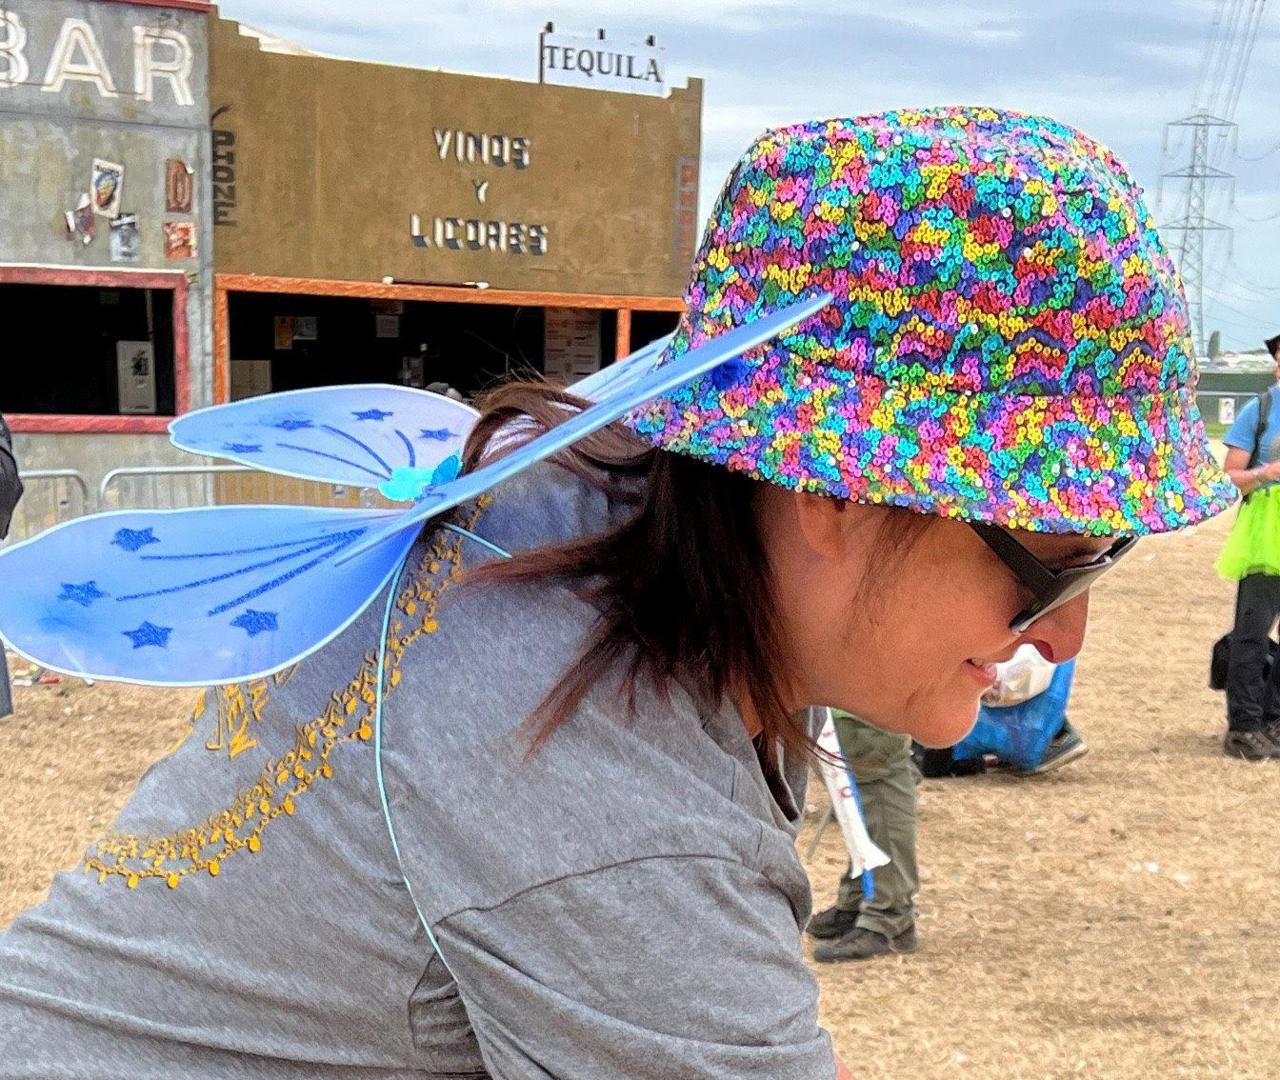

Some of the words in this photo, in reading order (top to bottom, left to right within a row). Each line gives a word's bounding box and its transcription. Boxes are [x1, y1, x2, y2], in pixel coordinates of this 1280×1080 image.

[544, 45, 664, 82] TEQUILA
[432, 127, 531, 170] VINOS
[472, 179, 489, 204] Y
[410, 213, 549, 256] LICORES
